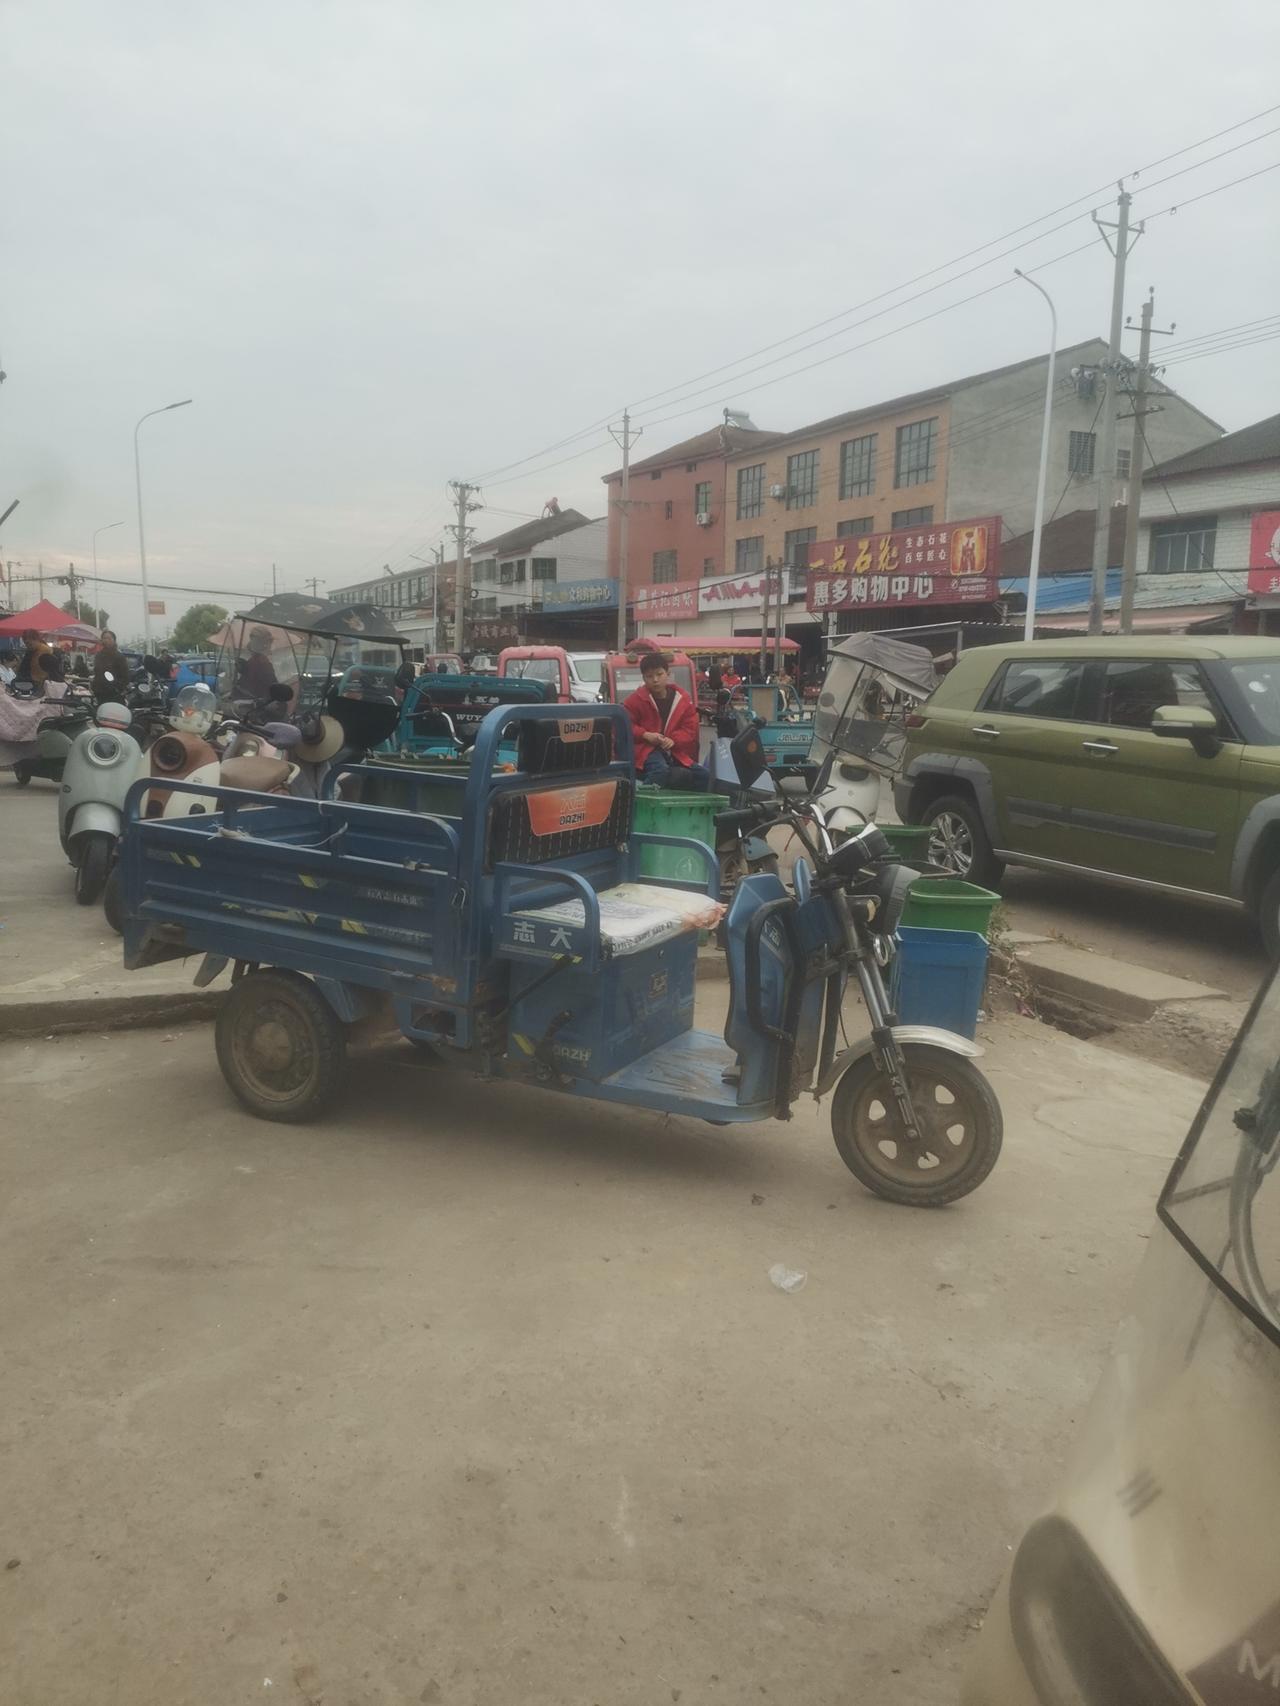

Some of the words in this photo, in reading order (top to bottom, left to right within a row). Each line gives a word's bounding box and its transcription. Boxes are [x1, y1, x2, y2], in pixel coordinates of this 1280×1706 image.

[814, 571, 933, 607] 惠多购物中心
[564, 723, 590, 734] DAZHI
[559, 812, 586, 825] DAZHI
